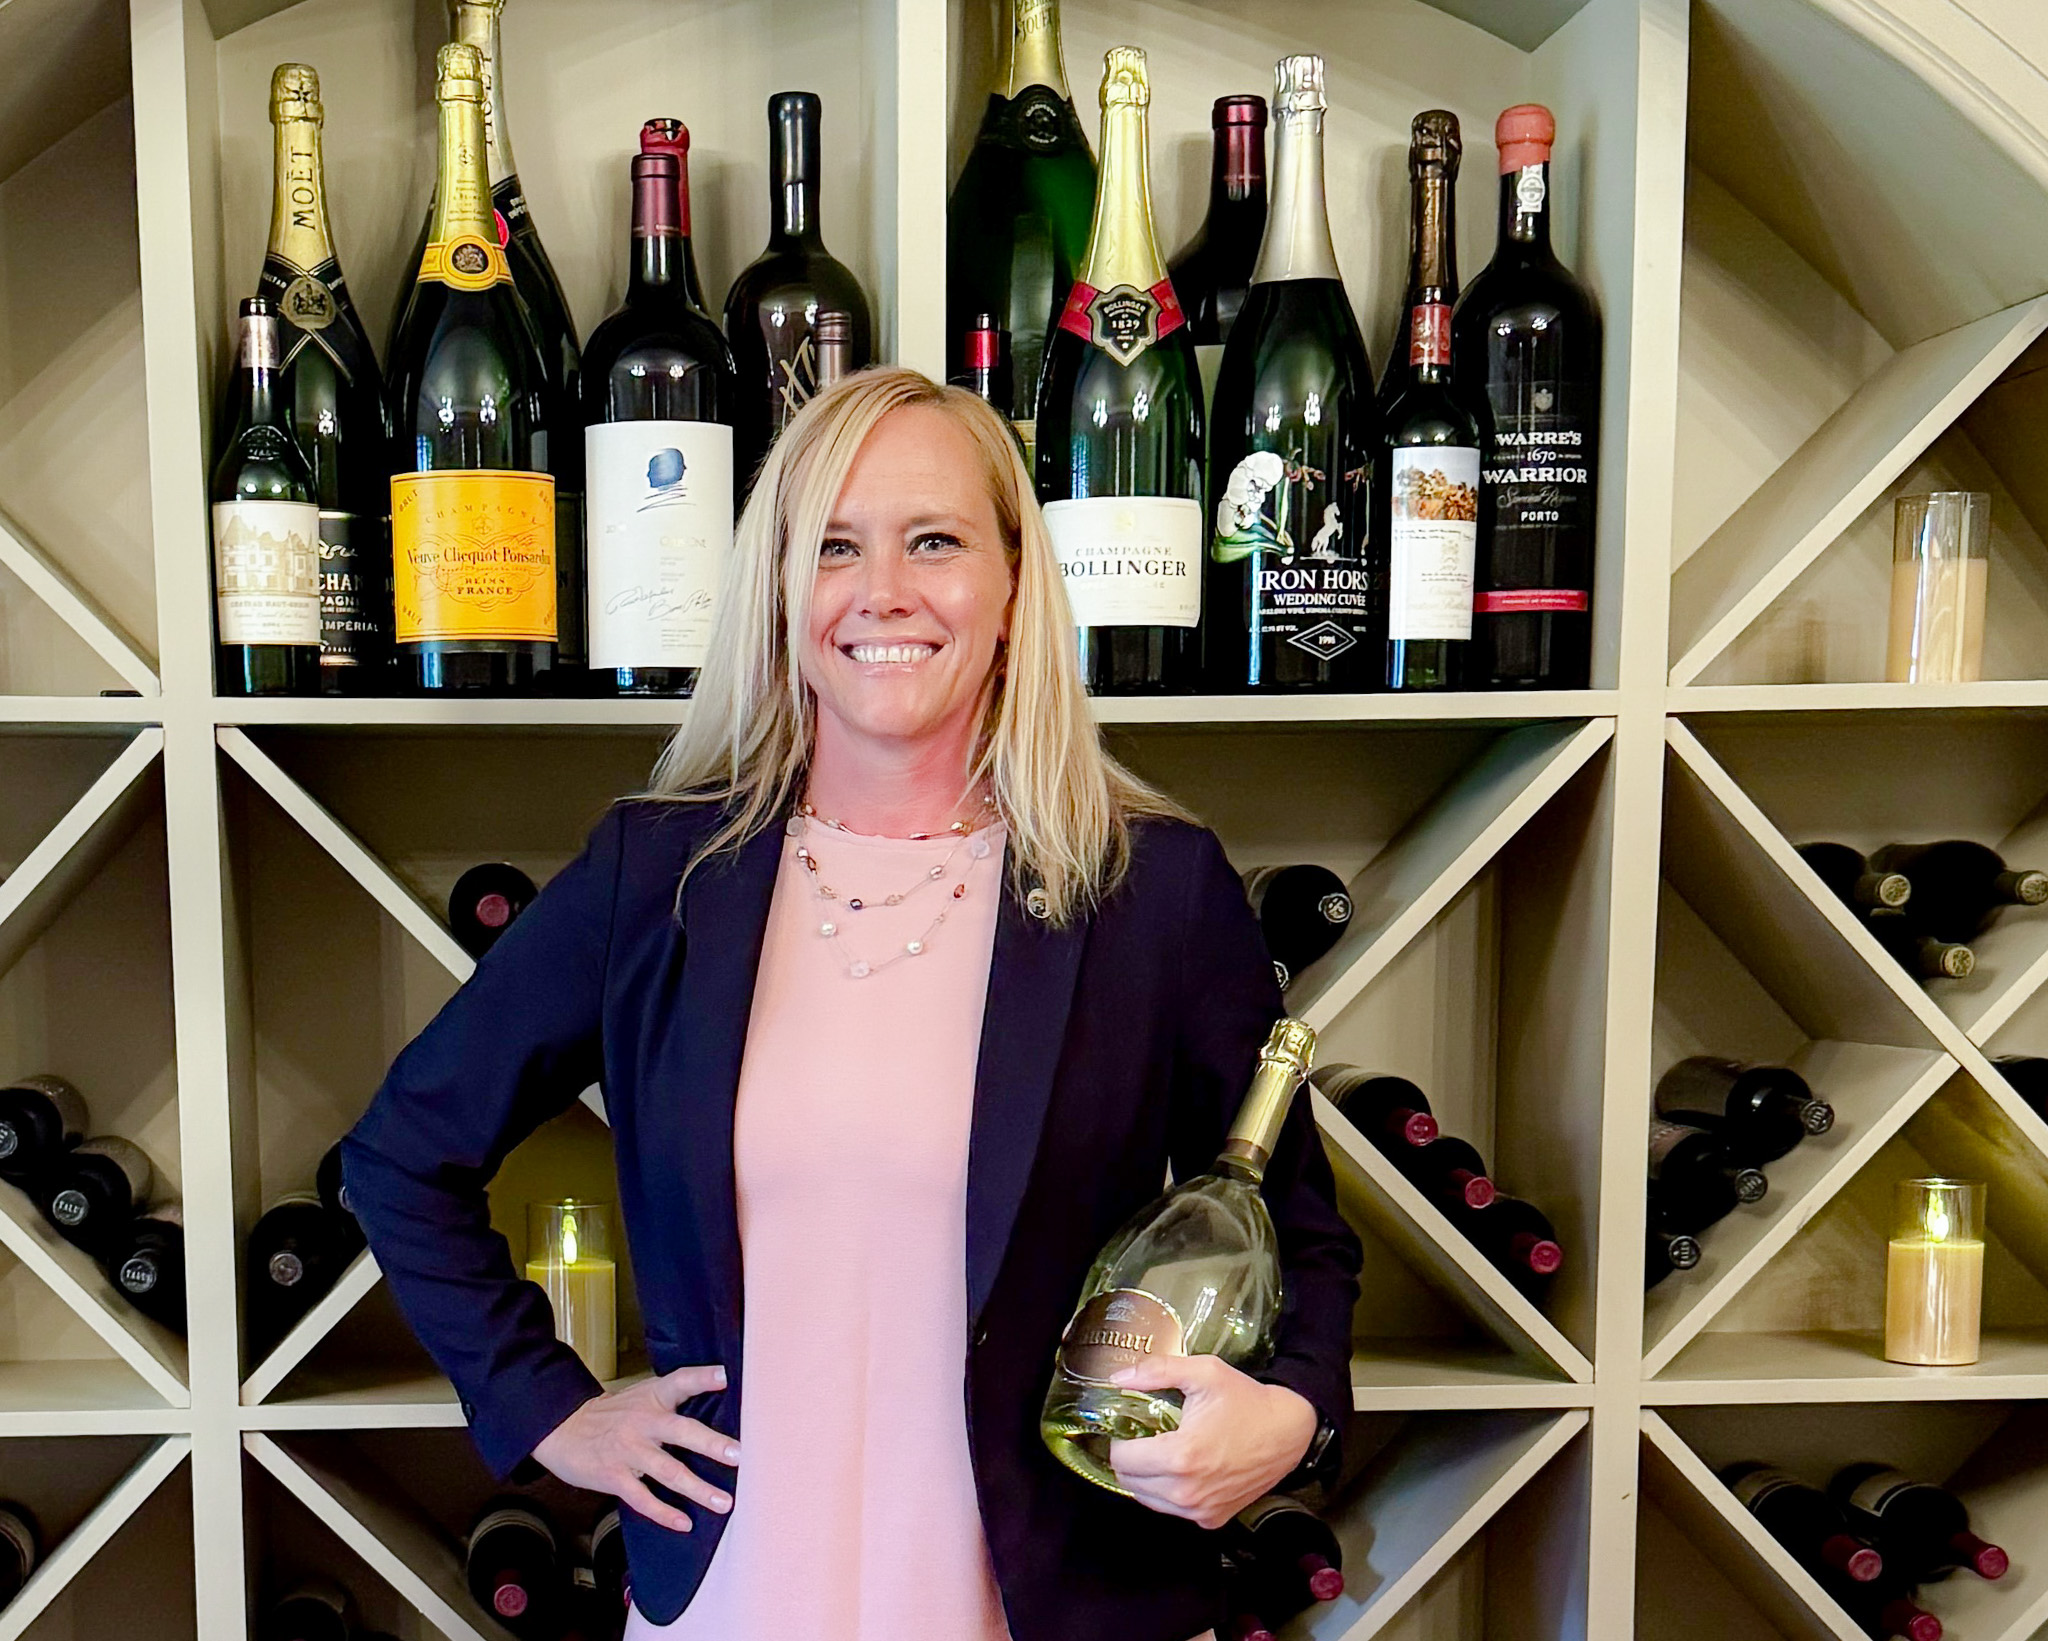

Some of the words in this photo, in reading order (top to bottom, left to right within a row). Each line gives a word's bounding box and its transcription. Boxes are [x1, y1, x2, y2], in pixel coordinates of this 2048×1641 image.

[1111, 319, 1140, 330] 1829
[1495, 431, 1582, 446] WARRE'S
[1527, 447, 1557, 465] 1670
[1482, 467, 1587, 484] WARRIOR
[1521, 511, 1559, 522] PORTO
[443, 546, 498, 565] Clicquot
[1075, 545, 1172, 557] CHAMPAGNE
[1059, 559, 1186, 577] BOLLINGER
[457, 586, 514, 595] FRANCE
[1273, 593, 1337, 606] WEDDING
